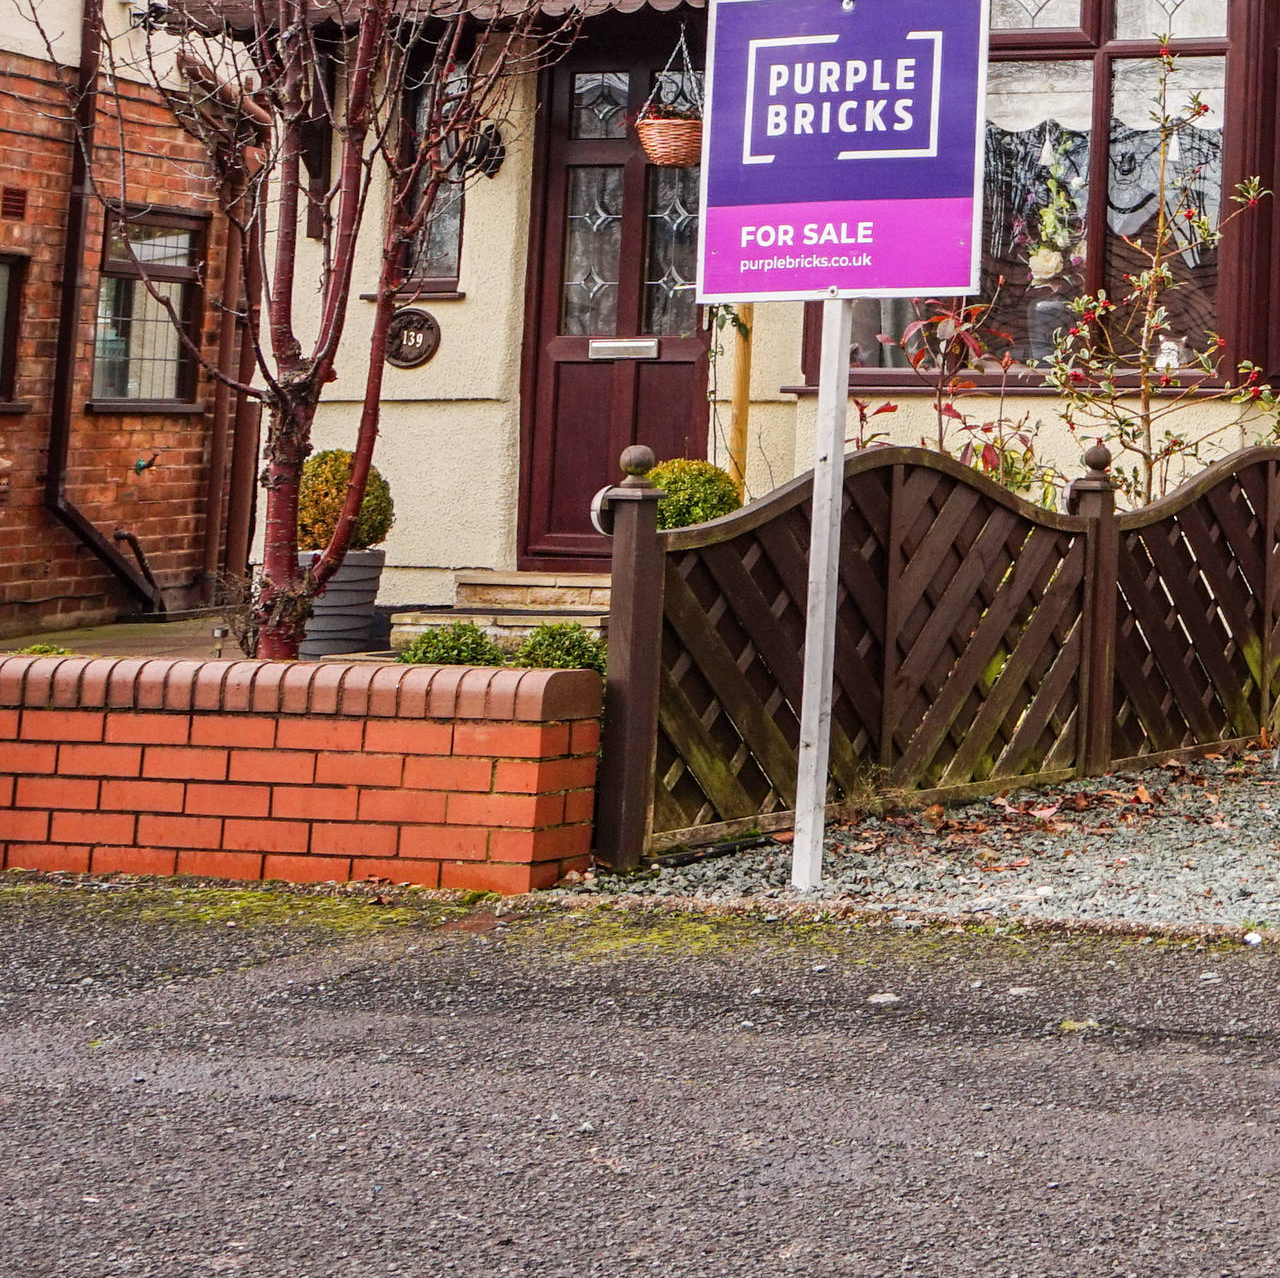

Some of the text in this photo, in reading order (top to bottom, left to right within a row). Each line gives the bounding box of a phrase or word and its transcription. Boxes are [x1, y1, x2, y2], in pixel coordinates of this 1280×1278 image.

[768, 57, 917, 96] PURPLE
[766, 98, 915, 137] BRICKS
[740, 221, 874, 248] FOR SALE
[739, 252, 872, 274] purplebricks.co.uk
[402, 330, 424, 348] 139
